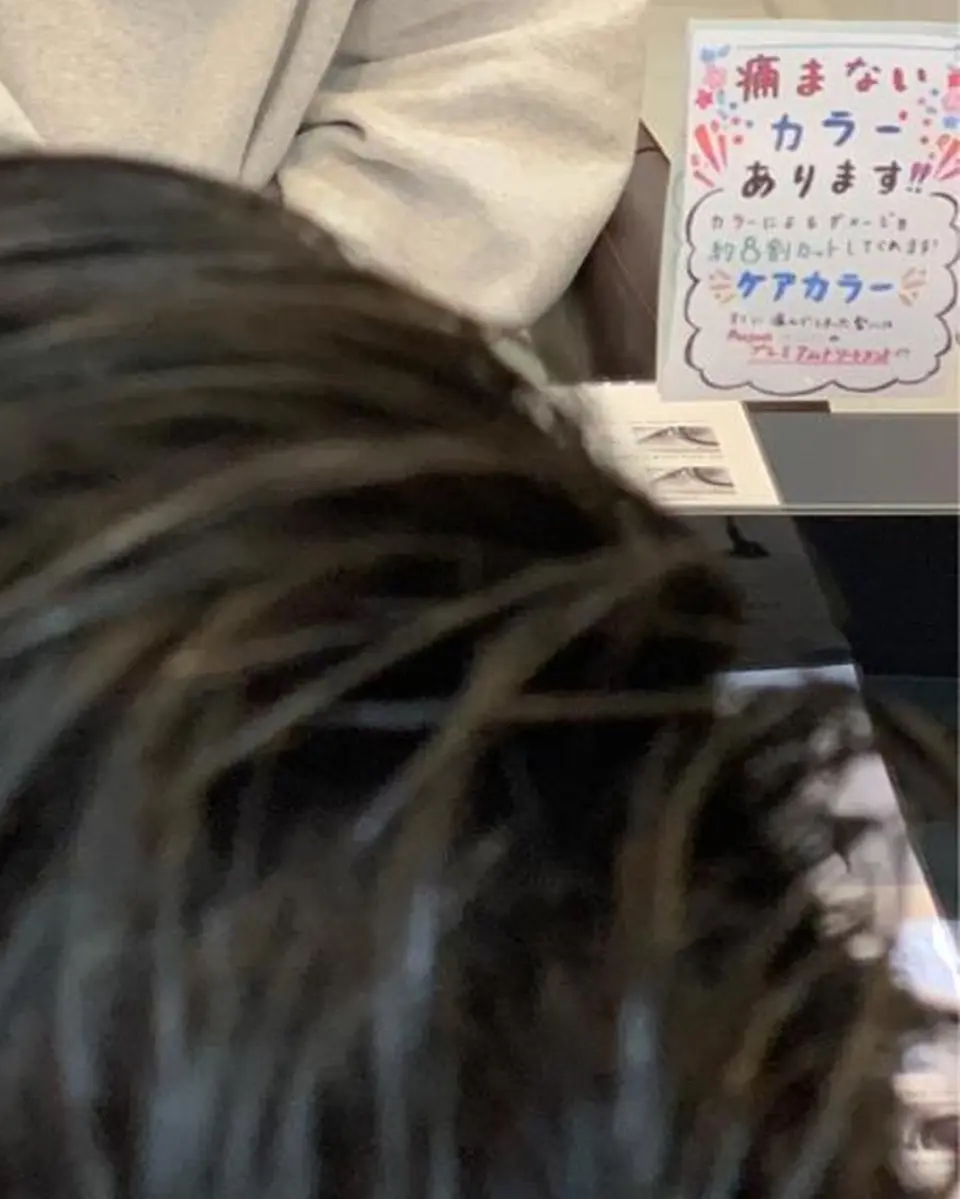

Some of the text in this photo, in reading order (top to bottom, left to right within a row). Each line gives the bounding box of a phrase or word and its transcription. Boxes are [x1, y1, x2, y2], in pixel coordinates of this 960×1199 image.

[735, 53, 927, 102] 痛まない
[771, 111, 902, 152] カラー
[736, 270, 895, 304] ケアカラー
